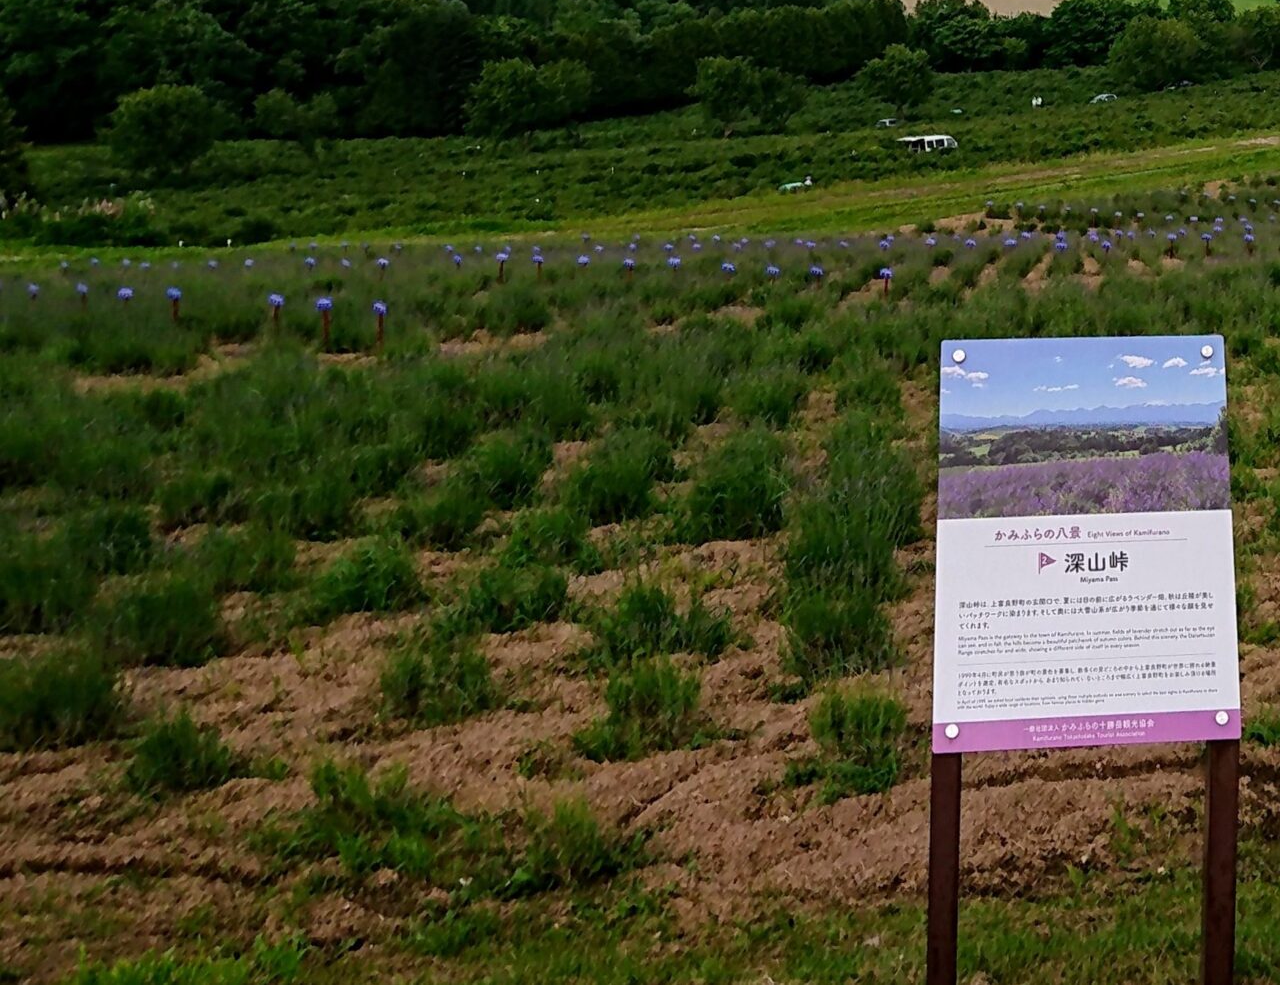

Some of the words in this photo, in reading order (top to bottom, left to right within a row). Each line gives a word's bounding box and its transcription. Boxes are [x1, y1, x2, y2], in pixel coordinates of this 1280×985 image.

[994, 526, 1081, 542] かみふらの八景
[1087, 531, 1104, 539] Eight
[1042, 555, 1048, 565] 2
[1064, 550, 1129, 573] 深山峠
[1080, 576, 1104, 585] Miyama
